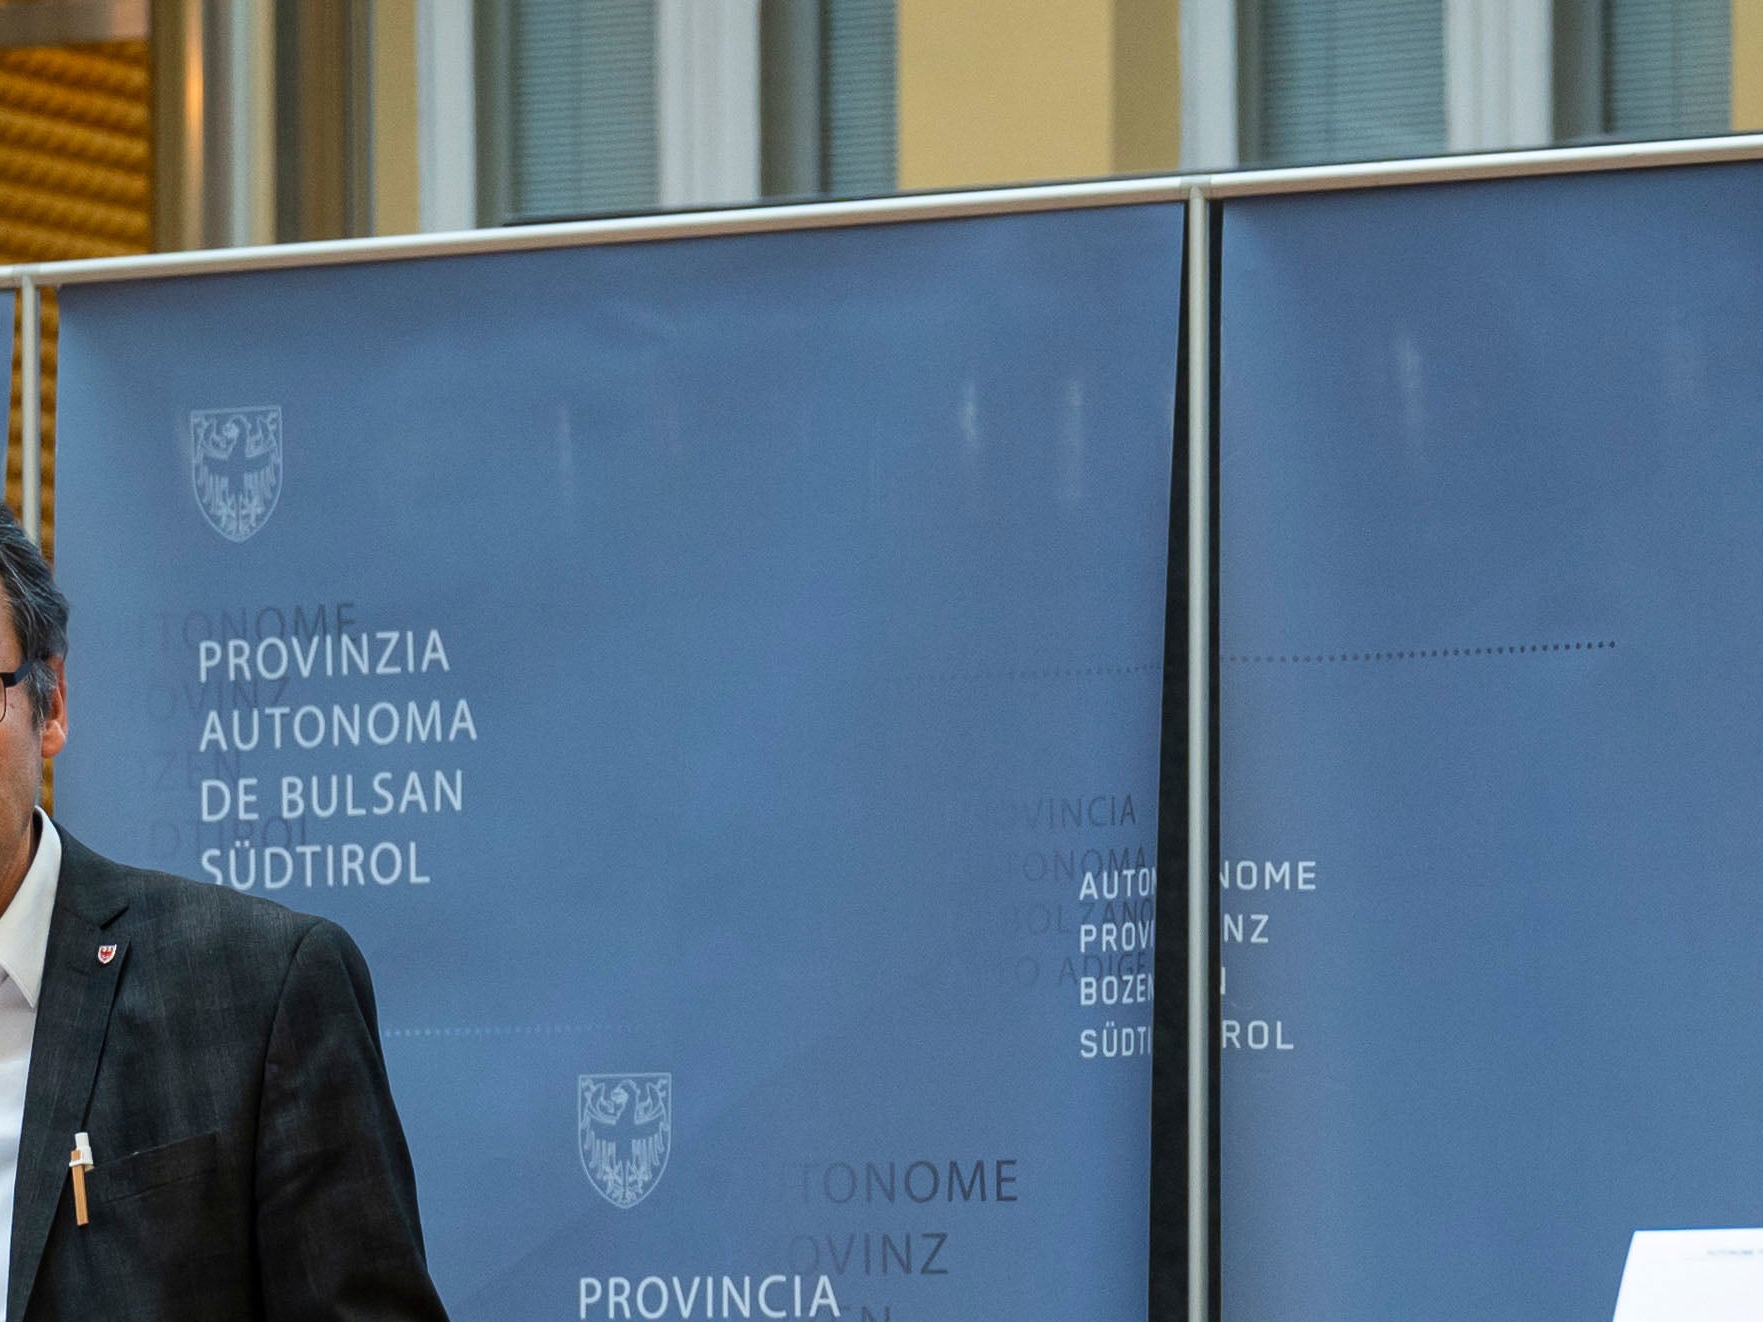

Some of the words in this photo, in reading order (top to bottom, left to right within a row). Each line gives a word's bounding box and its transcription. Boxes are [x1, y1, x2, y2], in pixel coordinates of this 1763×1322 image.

[198, 629, 451, 683] PROVINZIA
[198, 698, 478, 753] AUTONOMA
[200, 777, 259, 823] DE
[280, 768, 463, 819] BULSAN
[200, 839, 431, 891] SÜDTIROL
[579, 1274, 841, 1319] PROVINCIA
